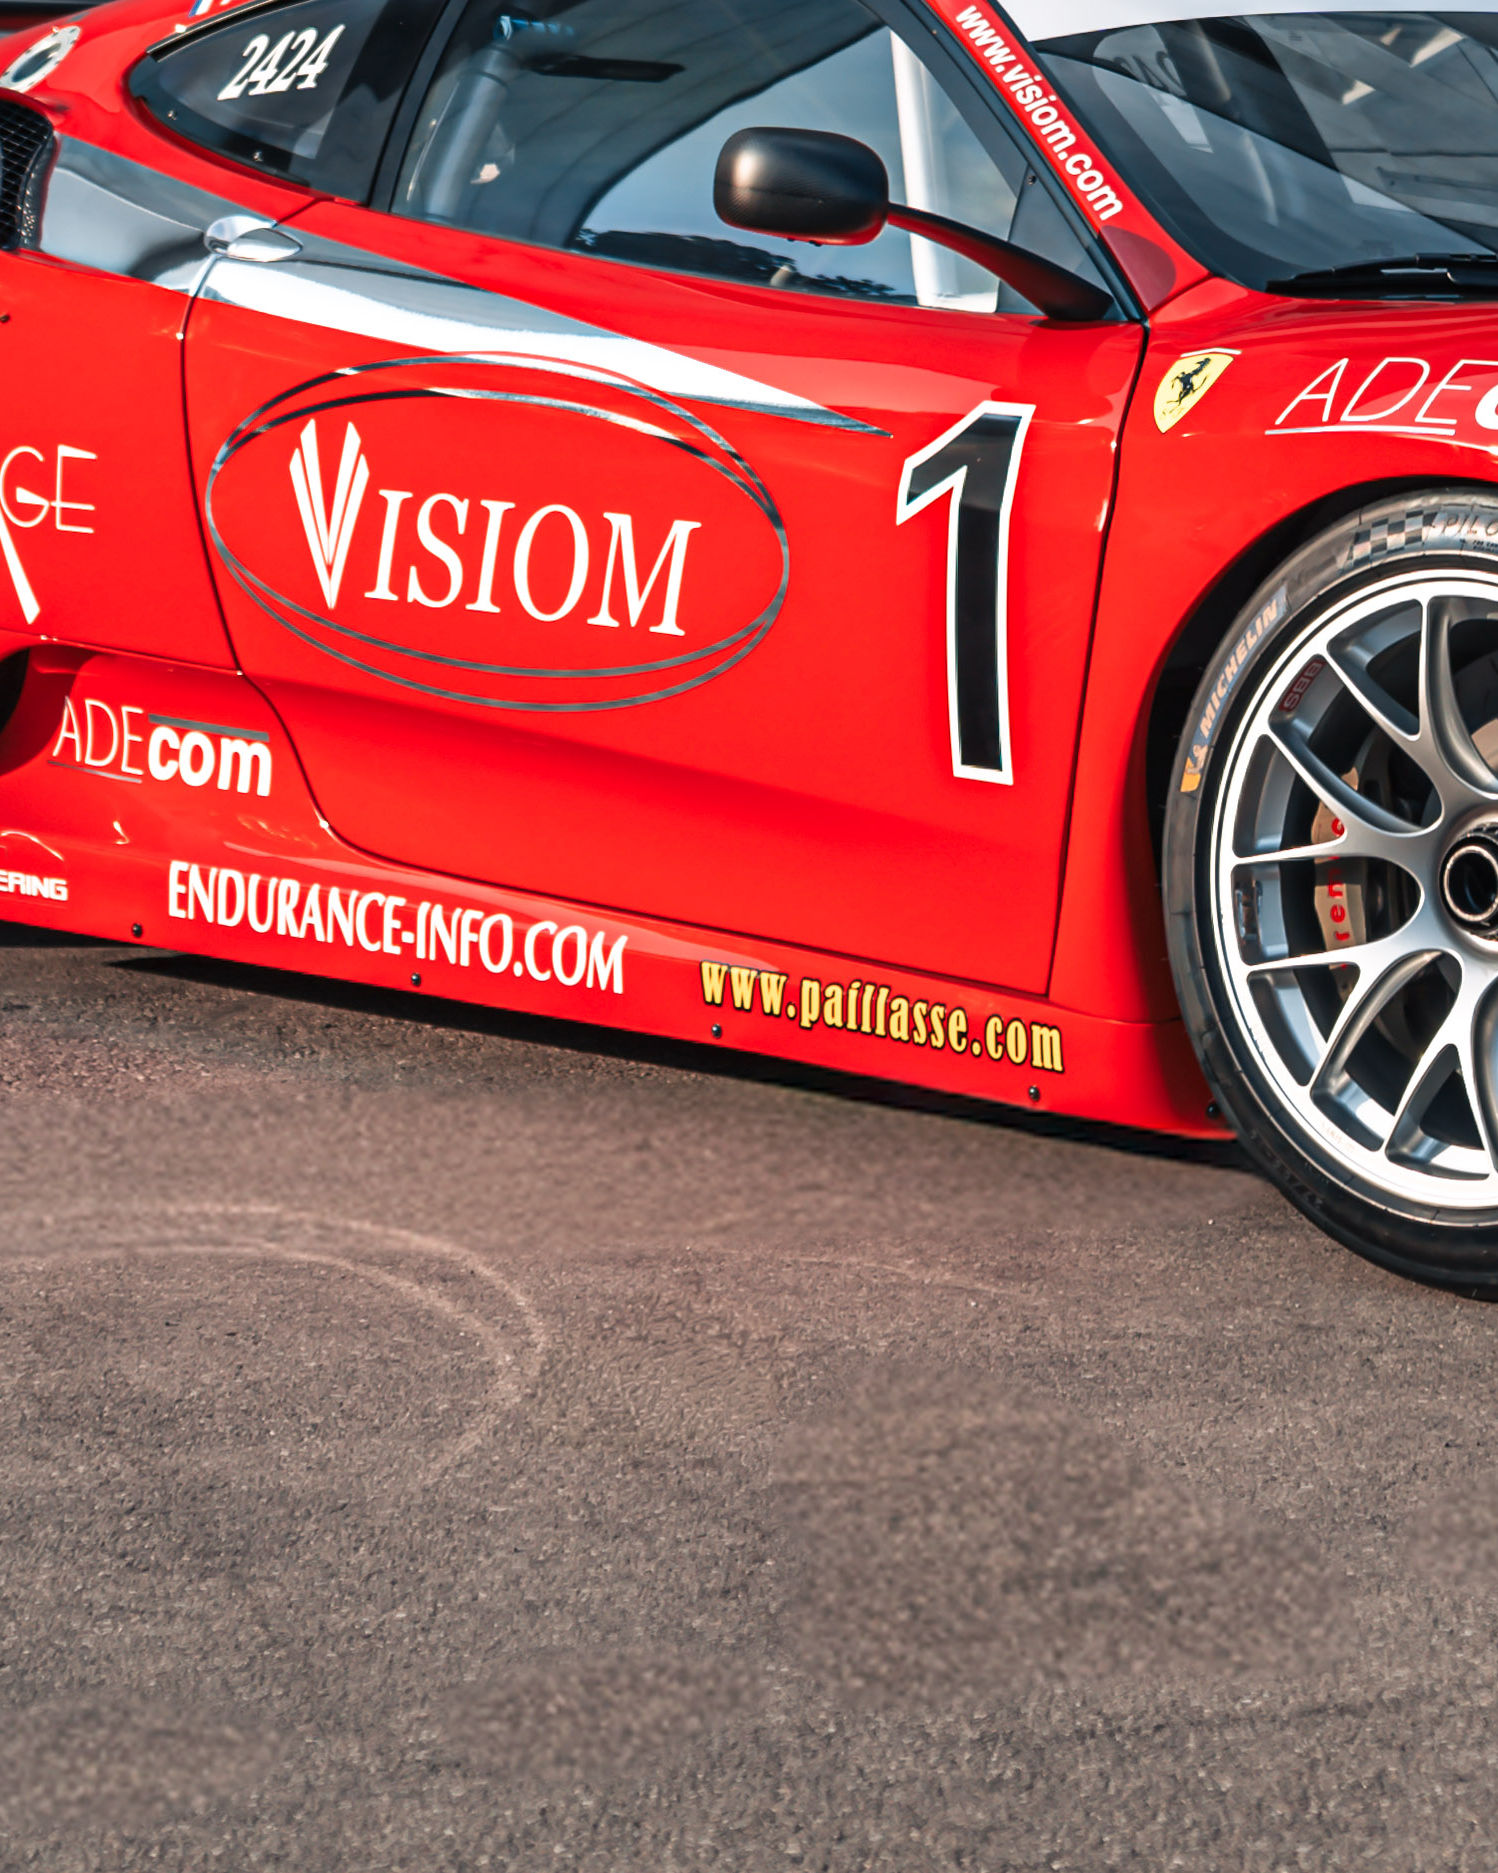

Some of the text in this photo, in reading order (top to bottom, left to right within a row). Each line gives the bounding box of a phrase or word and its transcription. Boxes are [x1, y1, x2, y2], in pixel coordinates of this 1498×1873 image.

[216, 23, 346, 102] 2424
[955, 5, 1123, 221] www.visiom.com
[288, 418, 703, 637] VISIOM
[896, 400, 1037, 786] 1
[1200, 599, 1278, 739] MICHELIN
[1284, 660, 1323, 713] BBS
[168, 860, 629, 994] ENDURANCE-INFO.COM
[700, 960, 1064, 1073] www.paillasse.com
